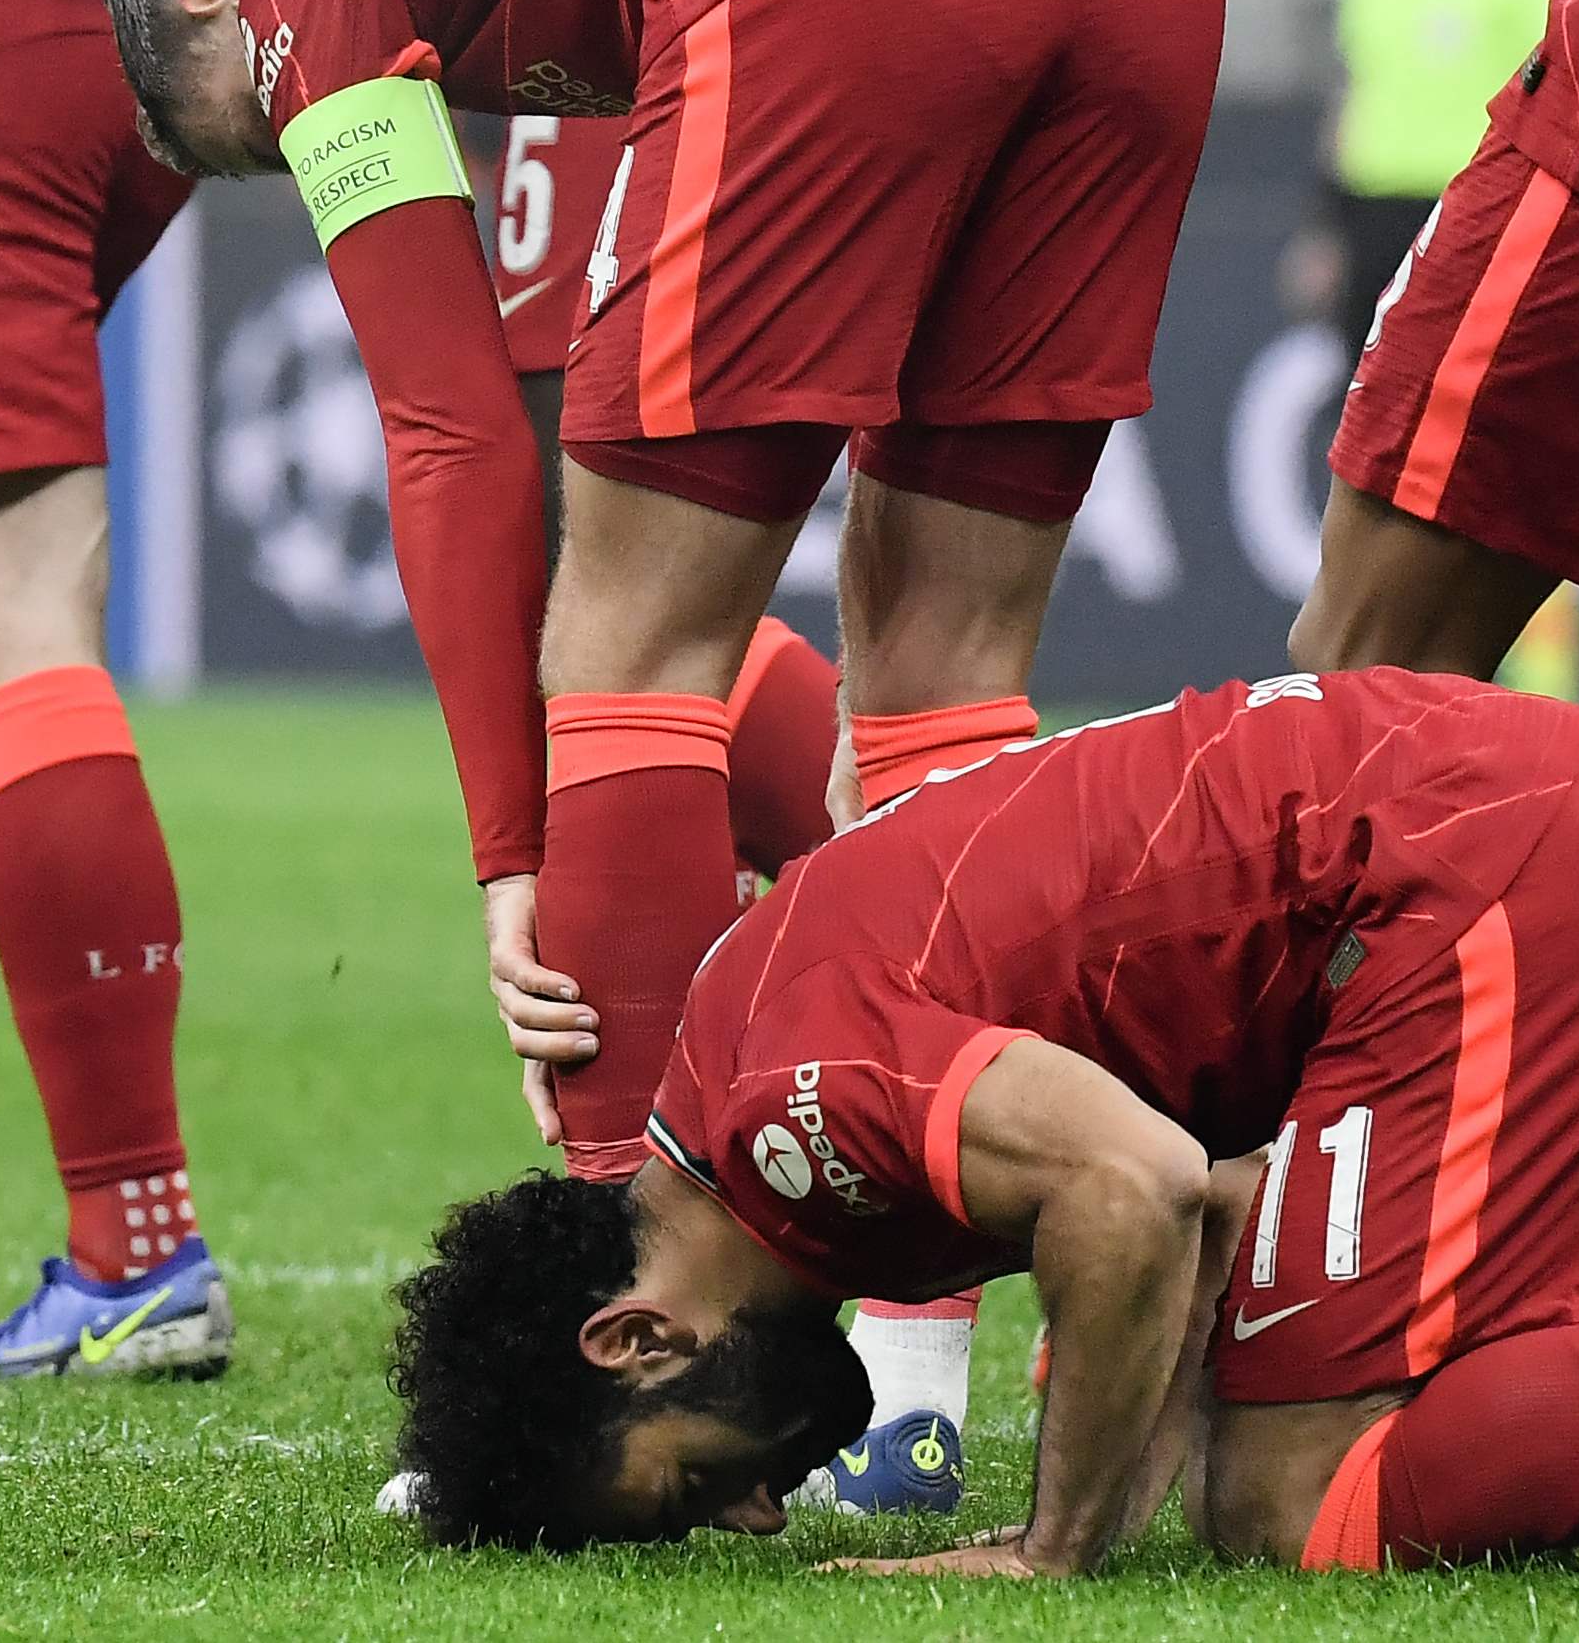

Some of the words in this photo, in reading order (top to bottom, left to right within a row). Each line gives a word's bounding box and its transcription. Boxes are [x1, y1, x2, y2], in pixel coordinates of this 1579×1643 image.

[312, 158, 391, 214] RESPECT
[313, 118, 397, 165] RACISM
[498, 114, 559, 274] 5
[1251, 1105, 1373, 1289] 11
